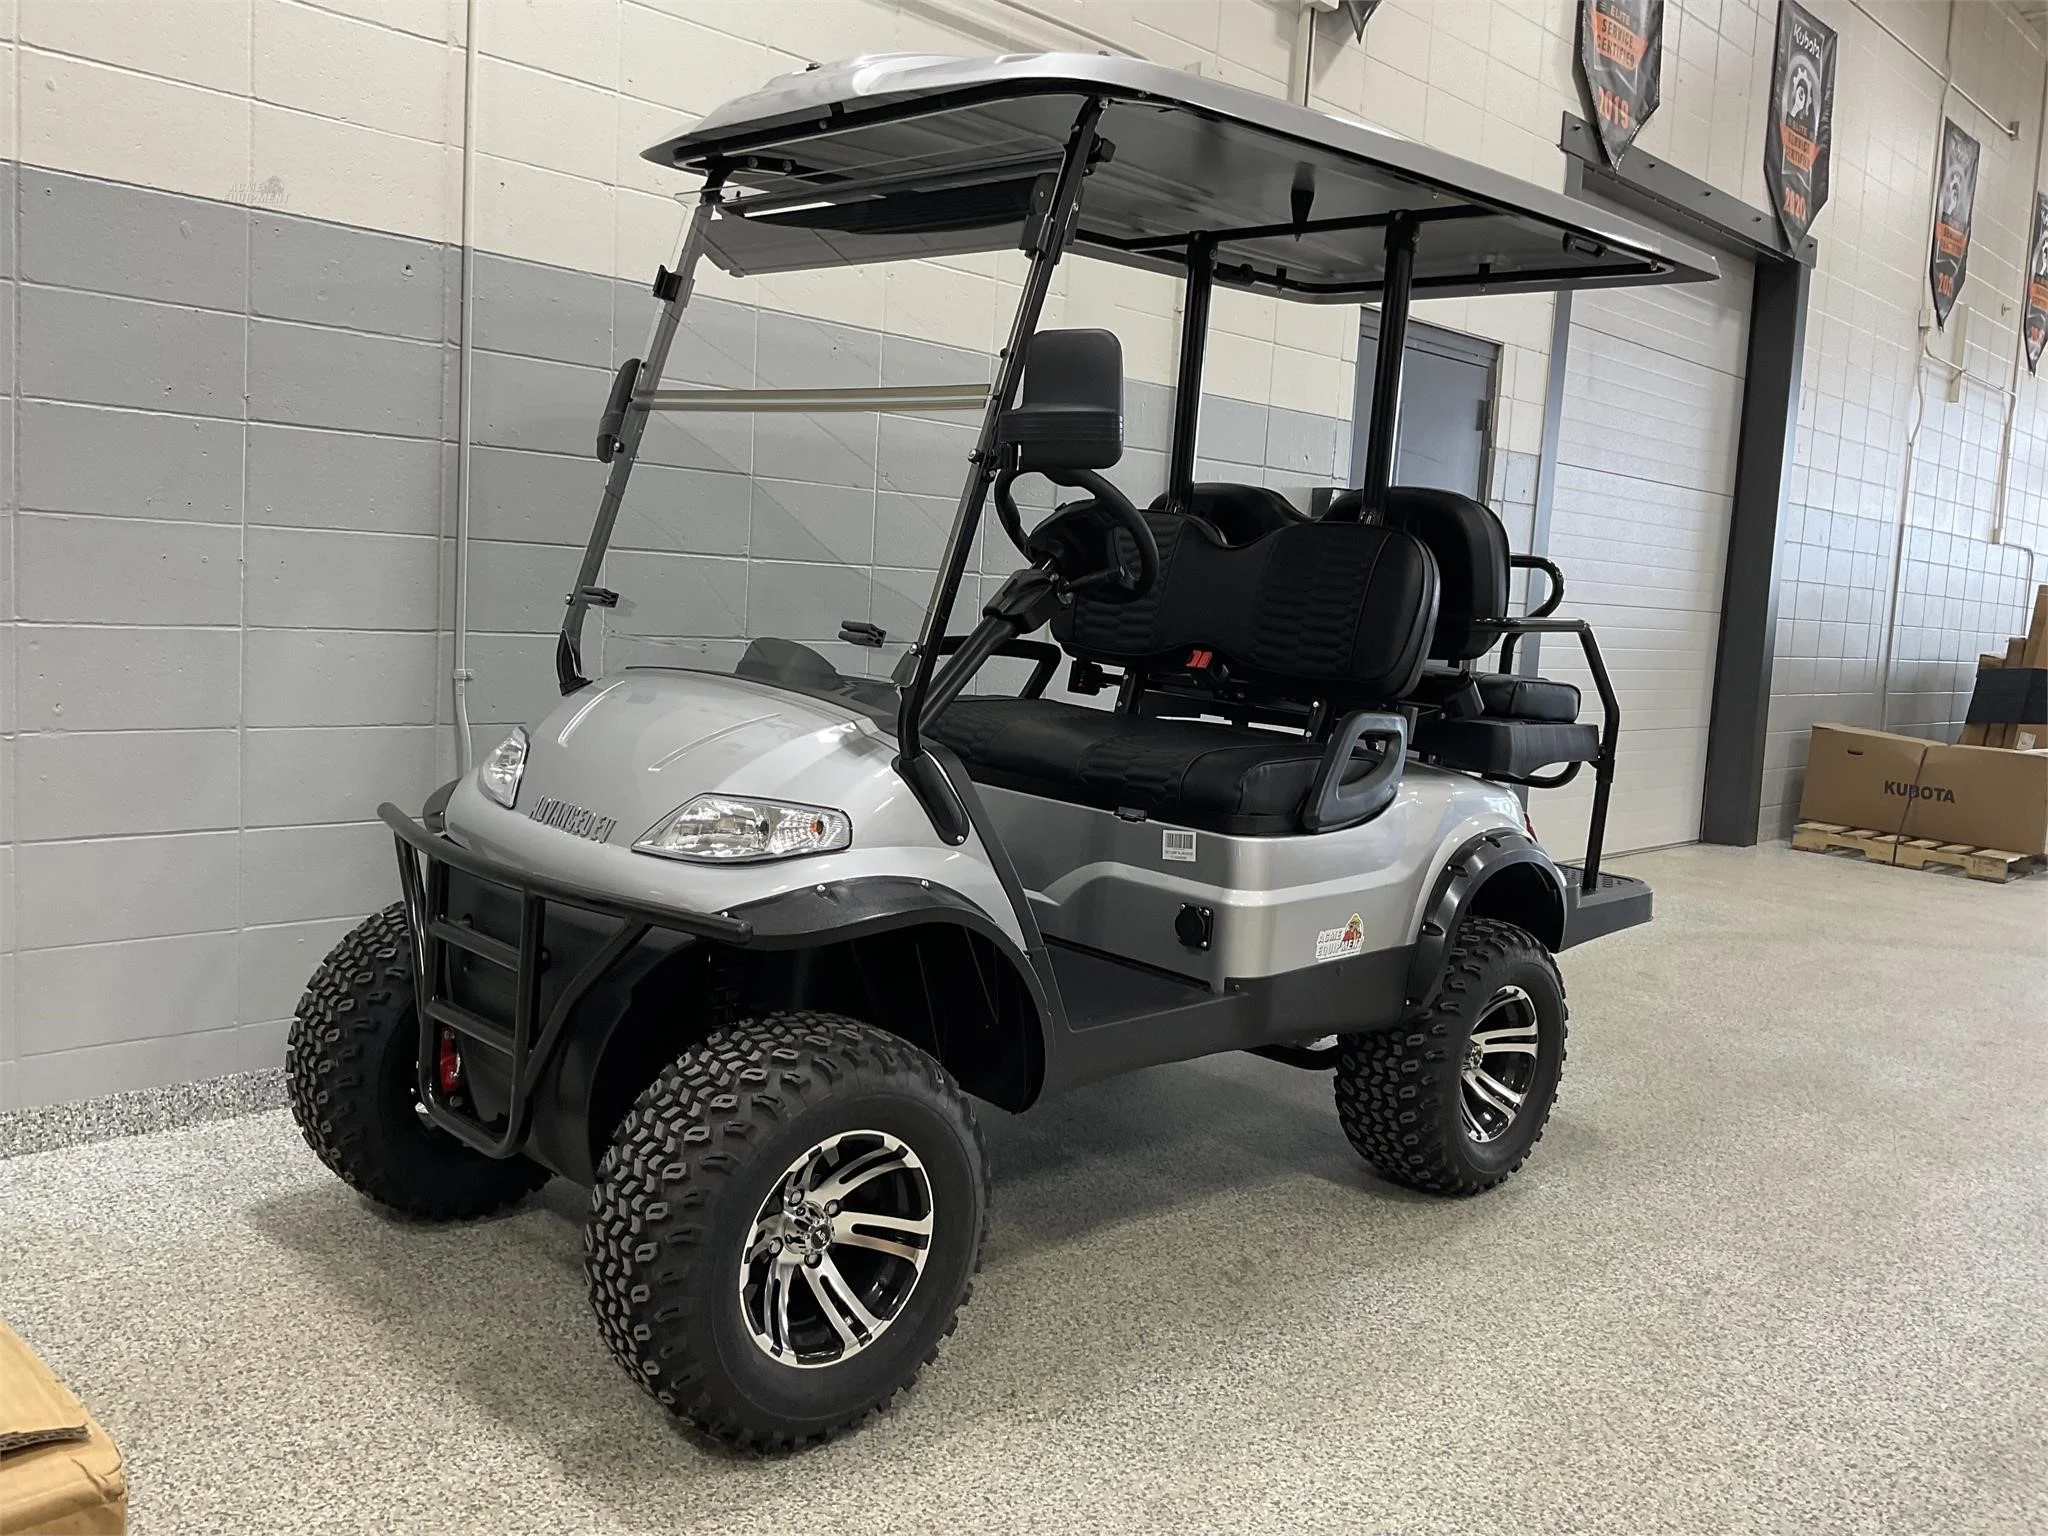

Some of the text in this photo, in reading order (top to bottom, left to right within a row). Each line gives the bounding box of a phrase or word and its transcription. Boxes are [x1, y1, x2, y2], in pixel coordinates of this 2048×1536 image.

[1610, 5, 1631, 26] ELITE
[1602, 18, 1633, 49] SERVICE
[1793, 23, 1820, 59] Kubota
[1599, 86, 1629, 129] 2019
[1884, 780, 1955, 803] KUBOTA
[529, 796, 597, 838] ADVANCED
